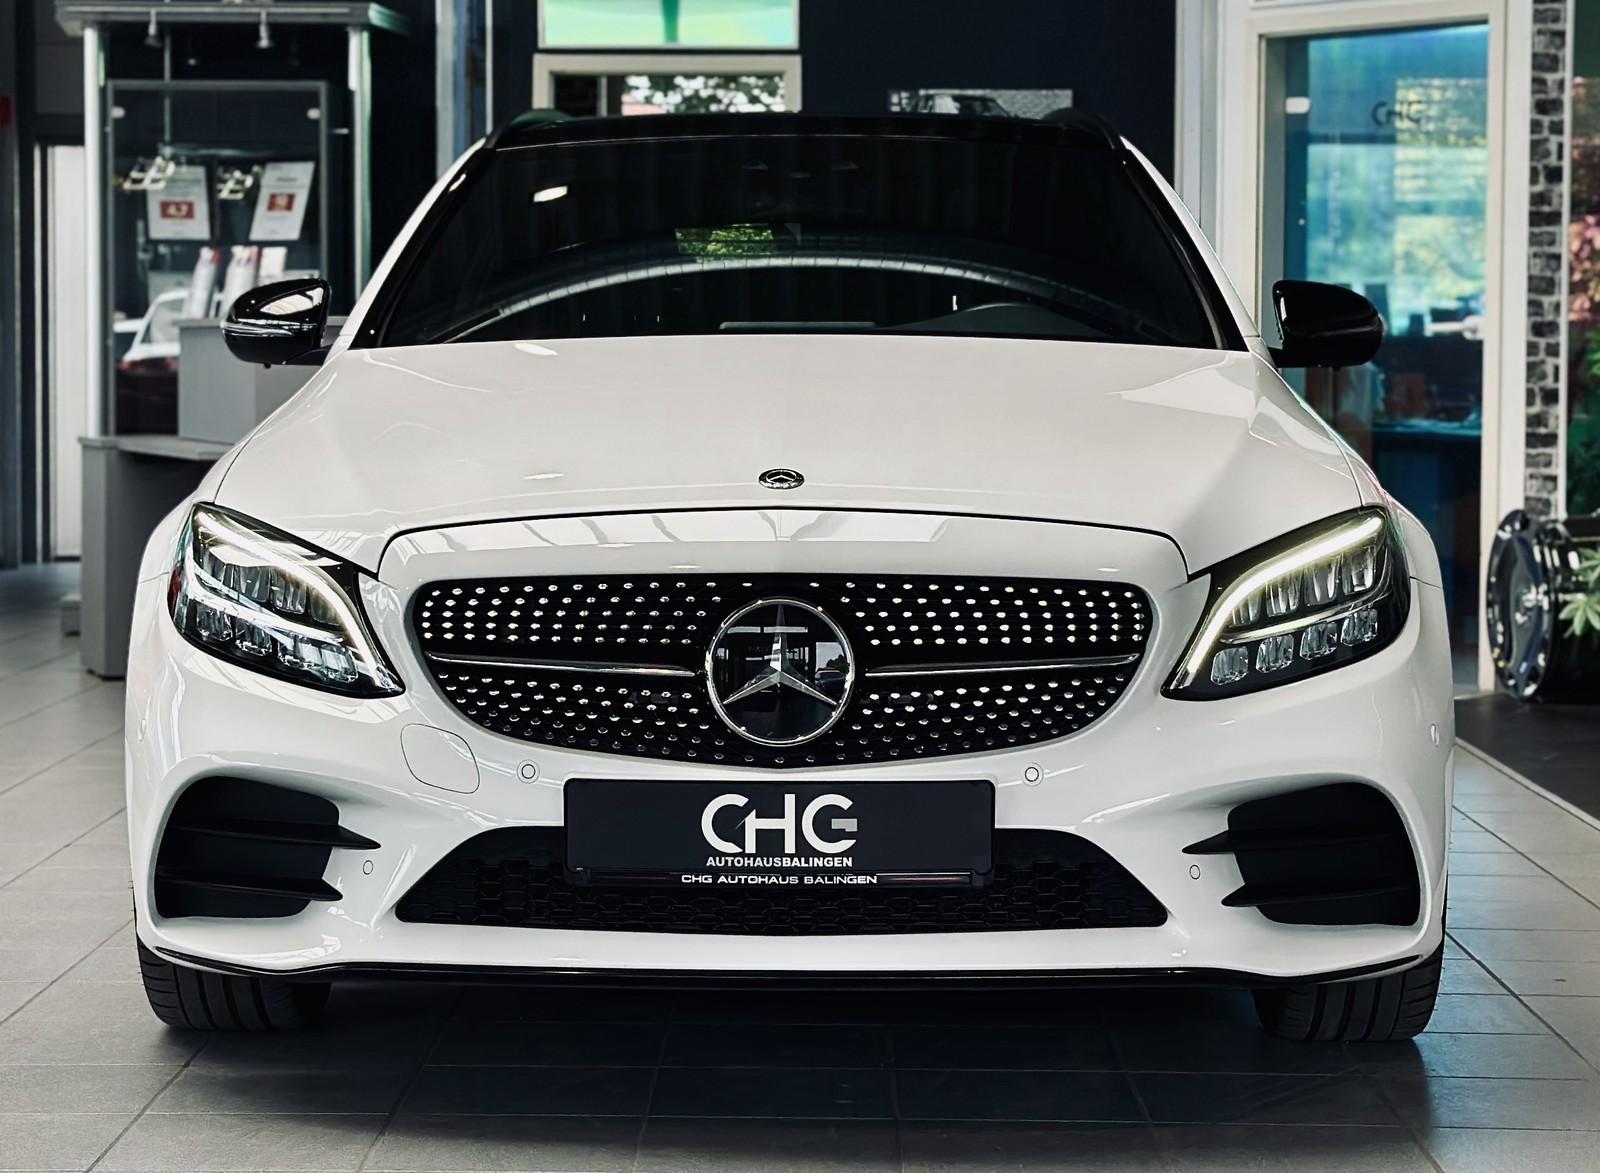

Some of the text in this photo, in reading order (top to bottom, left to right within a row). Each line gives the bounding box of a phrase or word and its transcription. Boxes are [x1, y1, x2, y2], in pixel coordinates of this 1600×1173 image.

[701, 794, 858, 855] CHG
[706, 857, 852, 868] AUTOHAUSBALINGEN
[681, 875, 878, 885] CHG AUTOHAUS BALINGEN
